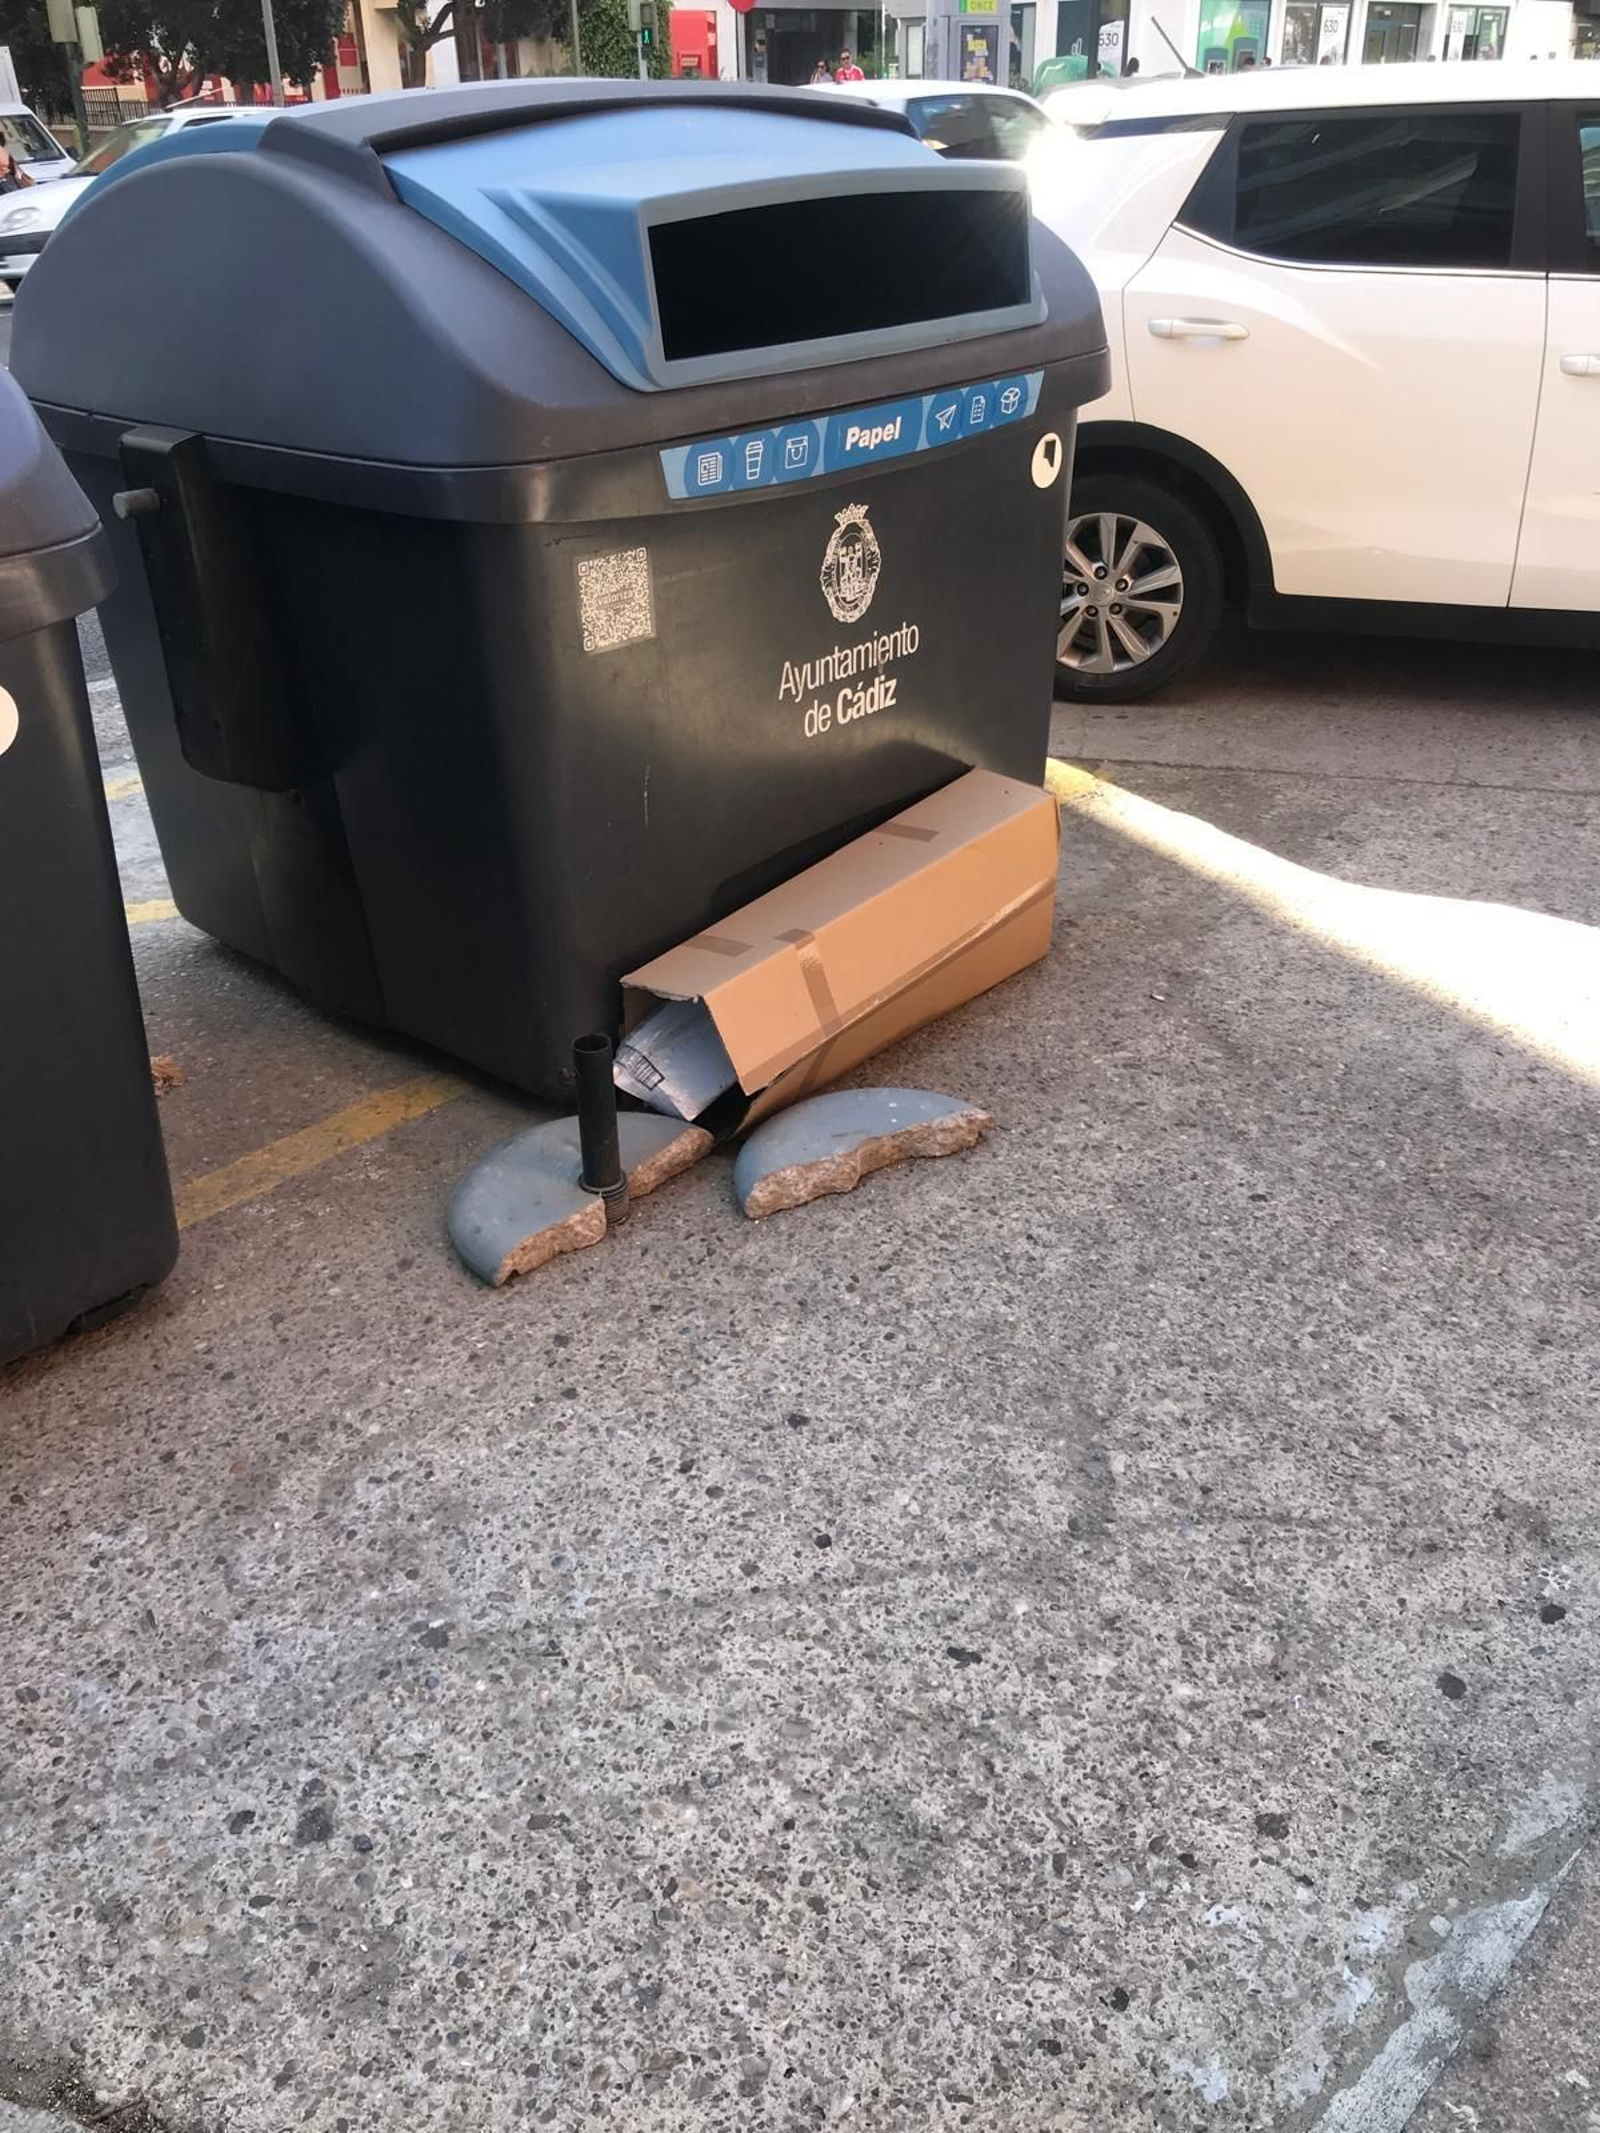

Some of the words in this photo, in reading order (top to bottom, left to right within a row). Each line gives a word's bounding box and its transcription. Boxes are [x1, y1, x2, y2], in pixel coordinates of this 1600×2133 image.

[970, 0, 995, 11] ONCE
[845, 415, 902, 451] Papel
[778, 621, 920, 703] Ayuntamiento
[804, 699, 832, 738] de
[836, 674, 898, 725] Cádiz
